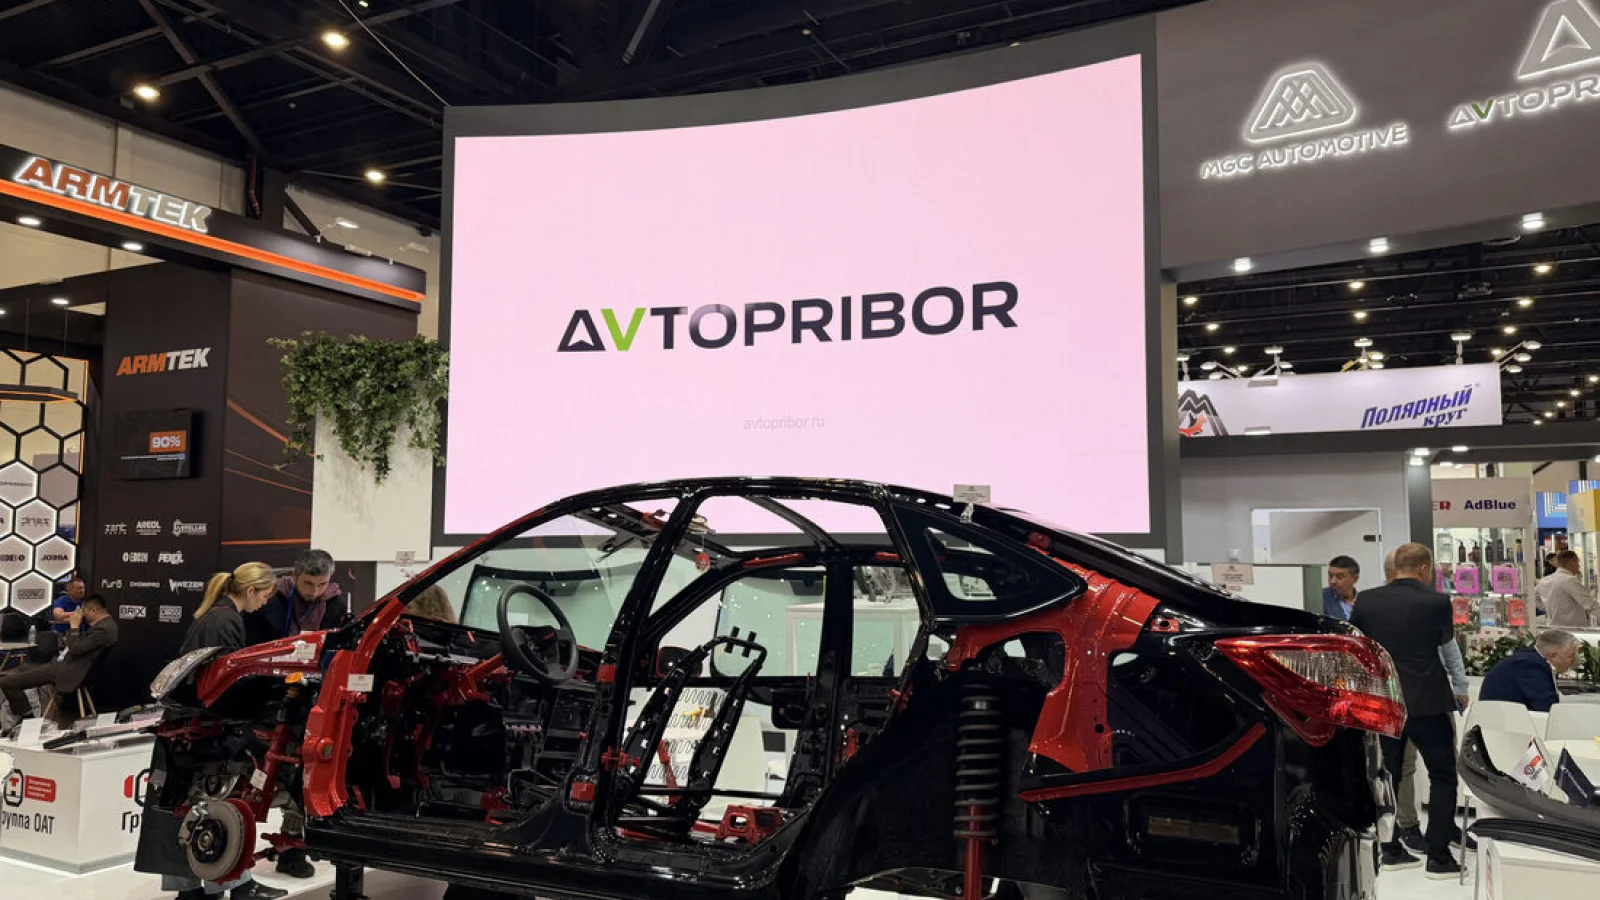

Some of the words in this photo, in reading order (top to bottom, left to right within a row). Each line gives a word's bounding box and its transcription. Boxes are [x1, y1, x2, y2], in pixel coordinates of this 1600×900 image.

[1200, 153, 1255, 180] MGC
[1258, 124, 1408, 169] AUTOMOTIVE
[14, 156, 212, 233] ARMTEK
[556, 281, 1019, 353] AVTOPRIBOR
[116, 346, 211, 376] ARMTEK
[1361, 383, 1473, 428] Полярный
[1422, 408, 1468, 428] круг
[743, 415, 825, 431] avtopribor.ru
[152, 435, 181, 449] 90%
[1464, 499, 1517, 510] AdBlue
[34, 813, 55, 835] ОАТ
